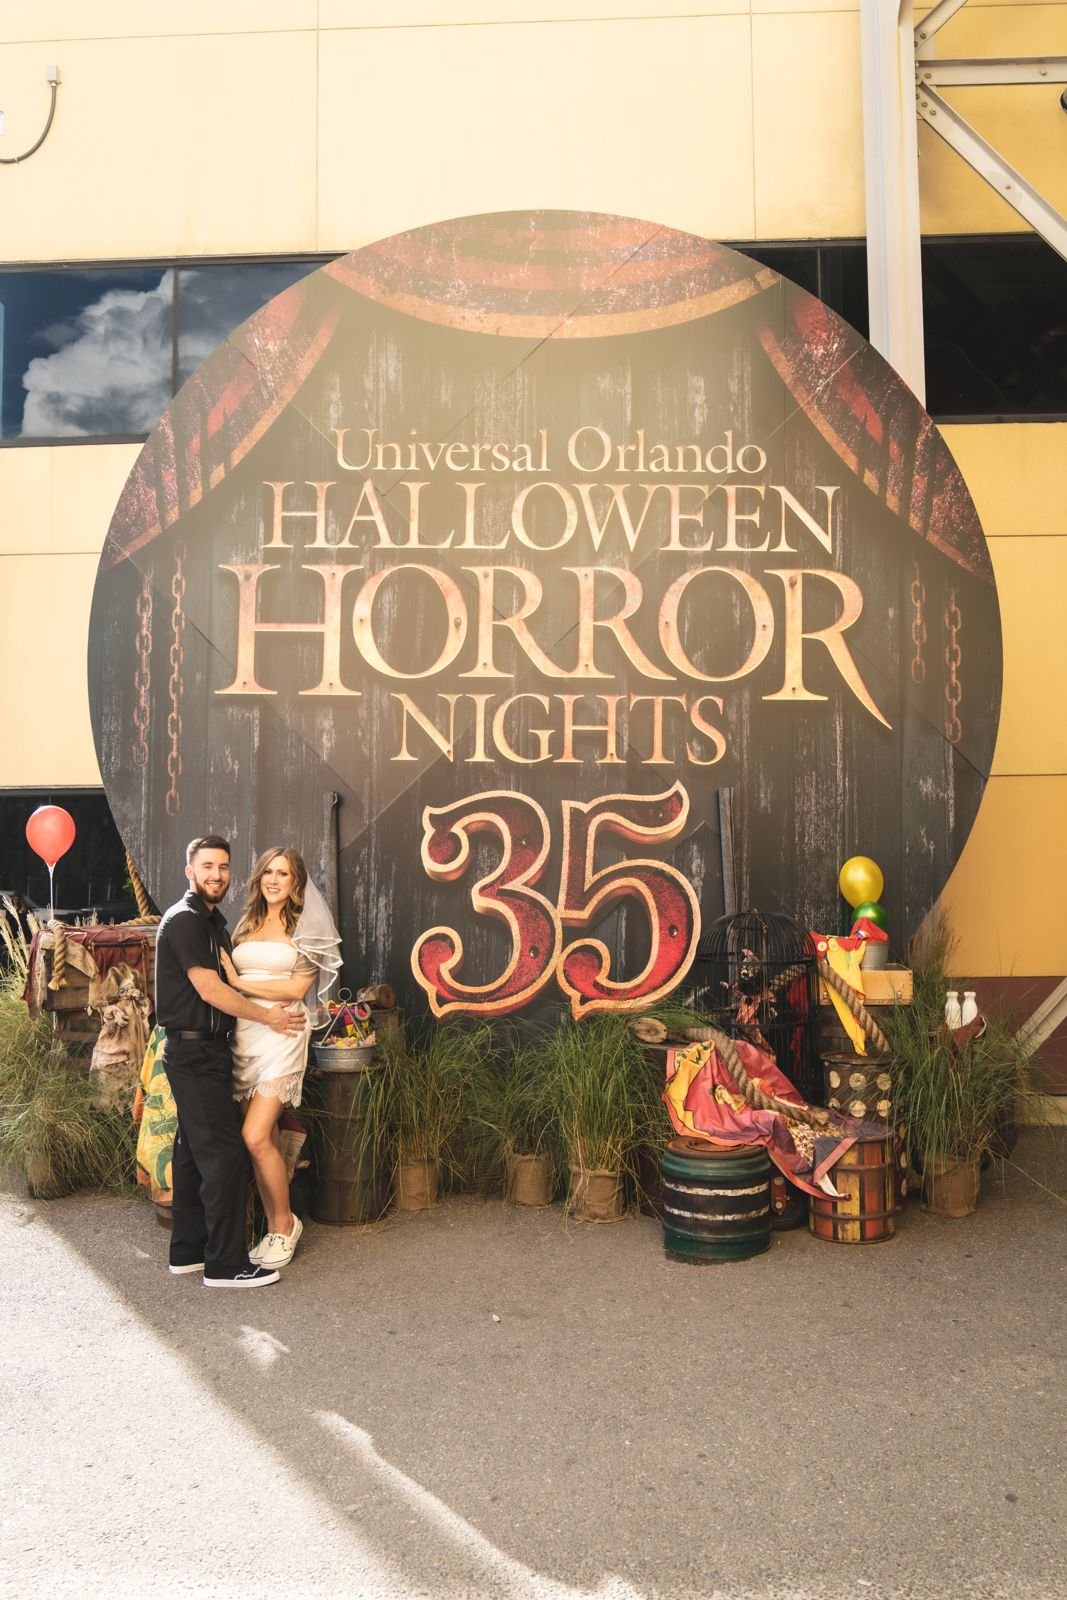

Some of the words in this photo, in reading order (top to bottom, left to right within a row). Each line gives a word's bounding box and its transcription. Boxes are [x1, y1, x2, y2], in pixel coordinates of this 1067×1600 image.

[332, 428, 551, 472] Universal
[567, 426, 767, 474] Orlando
[262, 479, 841, 555] HALLOWEEN
[214, 562, 893, 731] HORROR
[390, 693, 728, 766] NIGHTS
[410, 780, 701, 1020] 35
